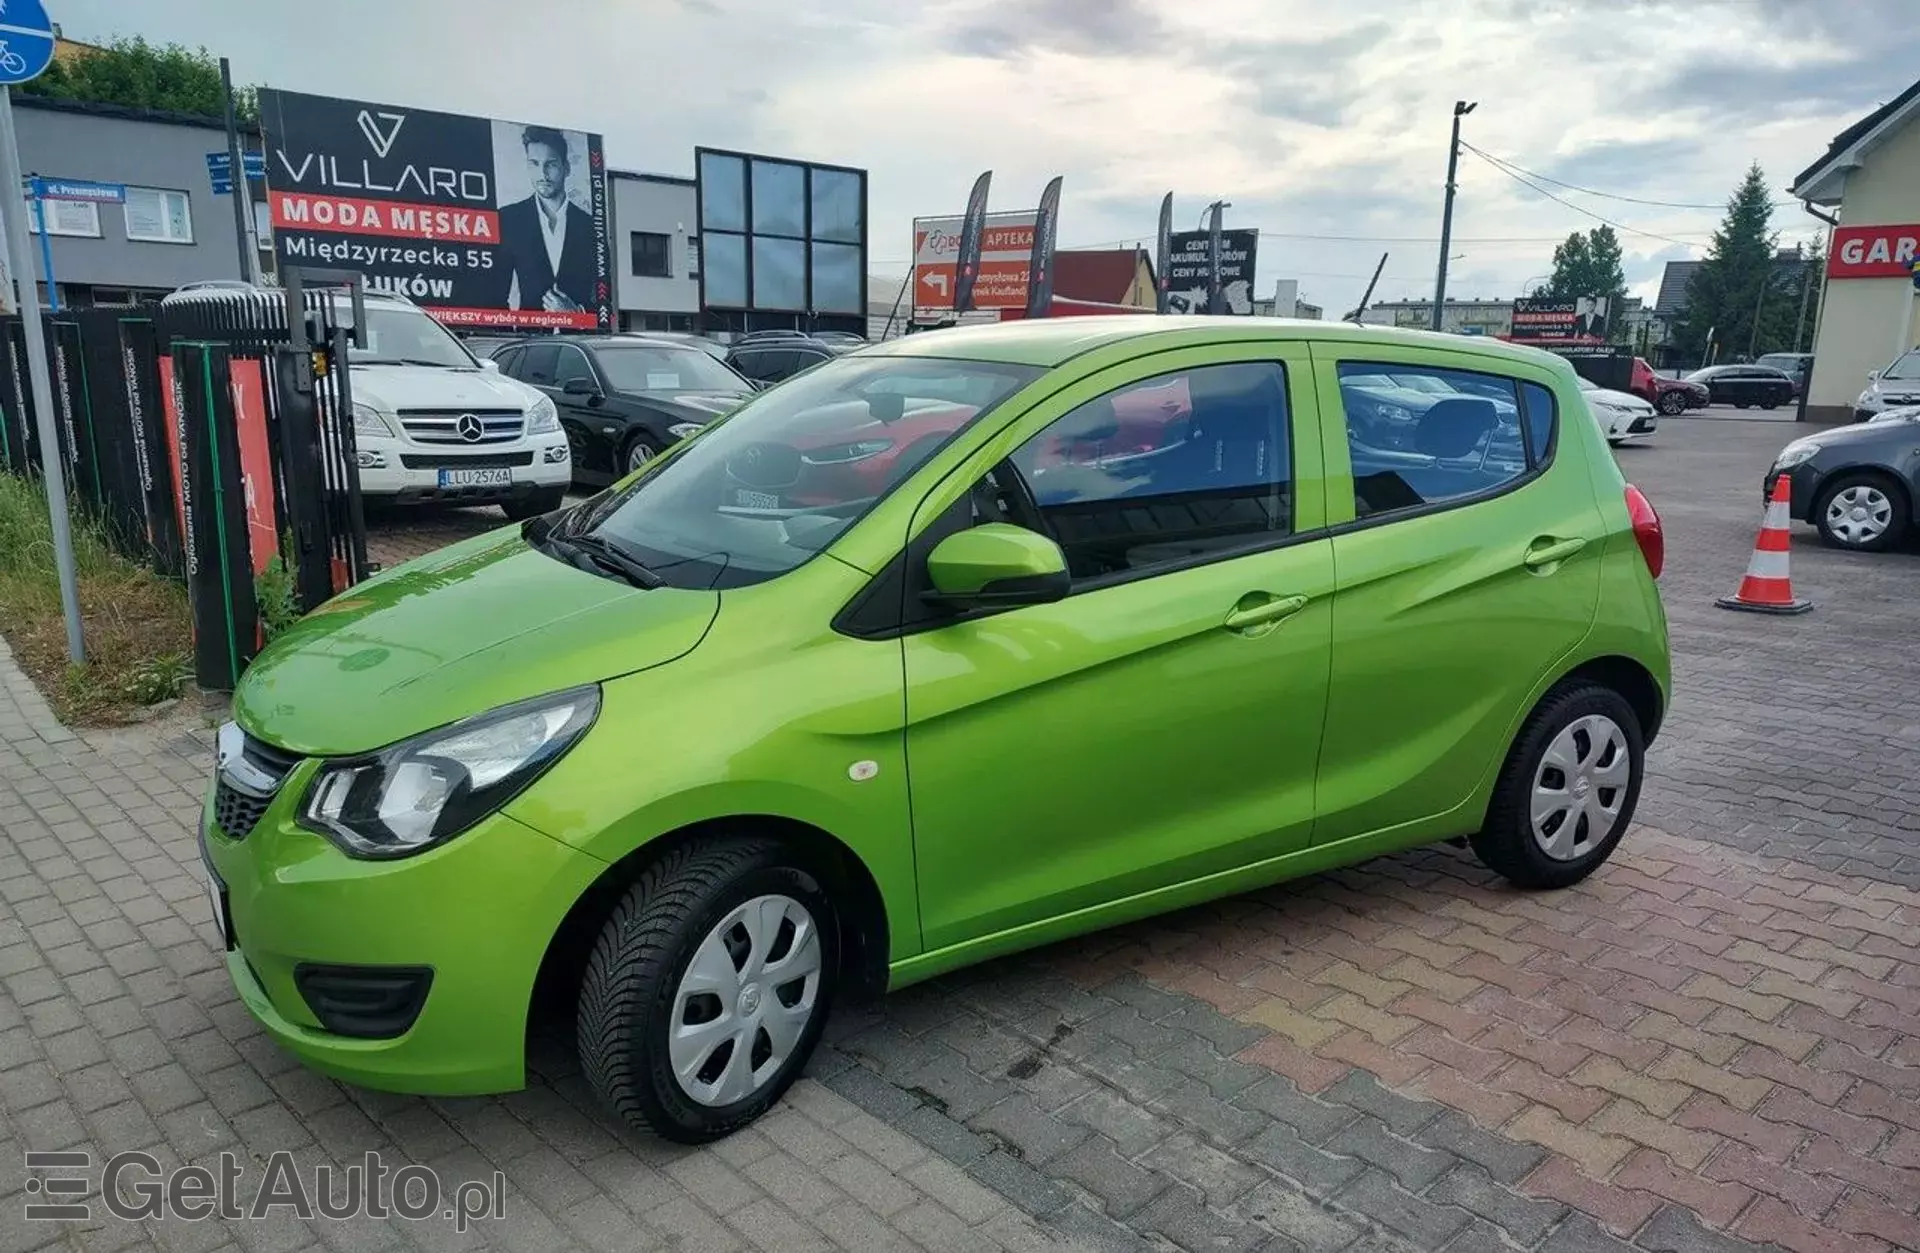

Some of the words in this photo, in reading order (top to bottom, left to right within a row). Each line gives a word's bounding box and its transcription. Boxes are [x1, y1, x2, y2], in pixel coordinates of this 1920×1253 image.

[276, 148, 488, 201] VILLARO
[282, 198, 382, 228] MODA
[391, 207, 492, 239] MĘSKA
[591, 173, 606, 278] www.villaro.pl
[286, 236, 459, 266] Międzyrzecka
[466, 250, 494, 268] 55
[987, 231, 1034, 247] APTEKA
[1186, 239, 1231, 251] CENTM
[431, 310, 482, 323] WIĘKSZY
[484, 312, 516, 324] wybór
[518, 314, 529, 323] w
[531, 313, 574, 326] regionie
[1528, 303, 1575, 312] VILLARO
[175, 380, 187, 441] YANOSIK
[180, 442, 188, 459] od
[181, 462, 192, 502] MOTO
[447, 470, 472, 485] LLU
[475, 469, 509, 484] 2576A
[184, 506, 199, 575] Ogłoszenia
